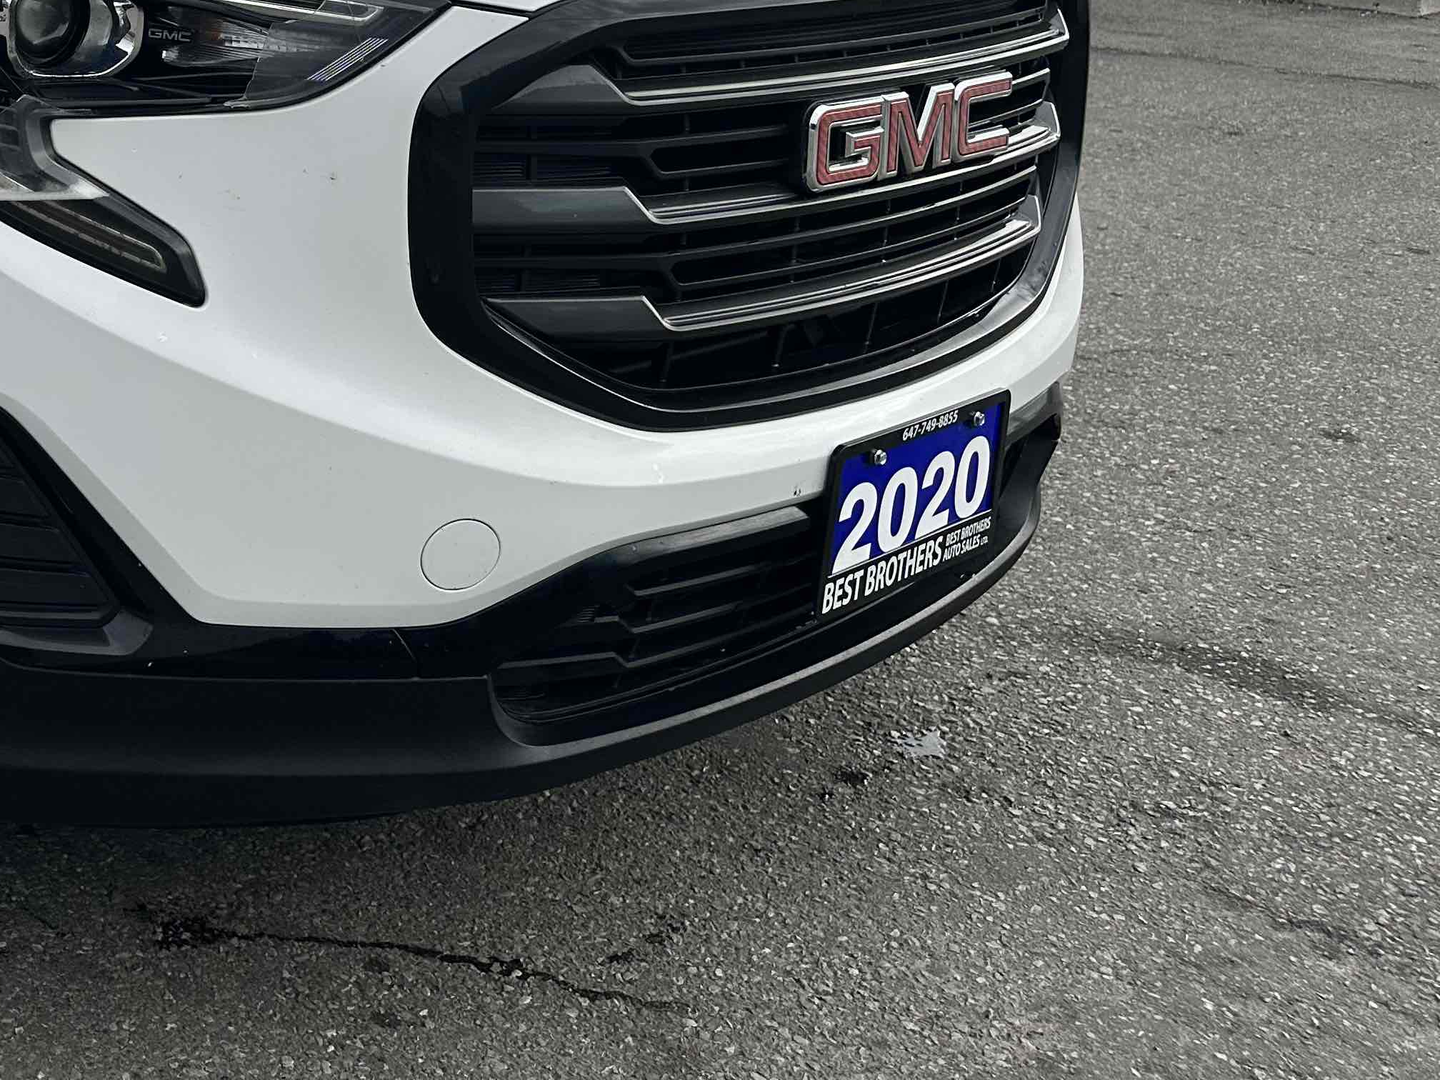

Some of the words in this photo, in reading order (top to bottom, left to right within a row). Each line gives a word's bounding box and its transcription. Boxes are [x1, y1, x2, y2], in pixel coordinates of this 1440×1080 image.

[148, 28, 192, 42] GMC
[806, 71, 1013, 193] GMC
[902, 409, 959, 441] 647-749-8855
[831, 436, 991, 575] 2020
[942, 542, 961, 562] AUTO
[960, 533, 981, 554] SALES
[945, 529, 961, 547] BEST
[960, 517, 991, 540] BROTHERS
[821, 569, 864, 615] BEST
[864, 535, 944, 598] BROTHERS
